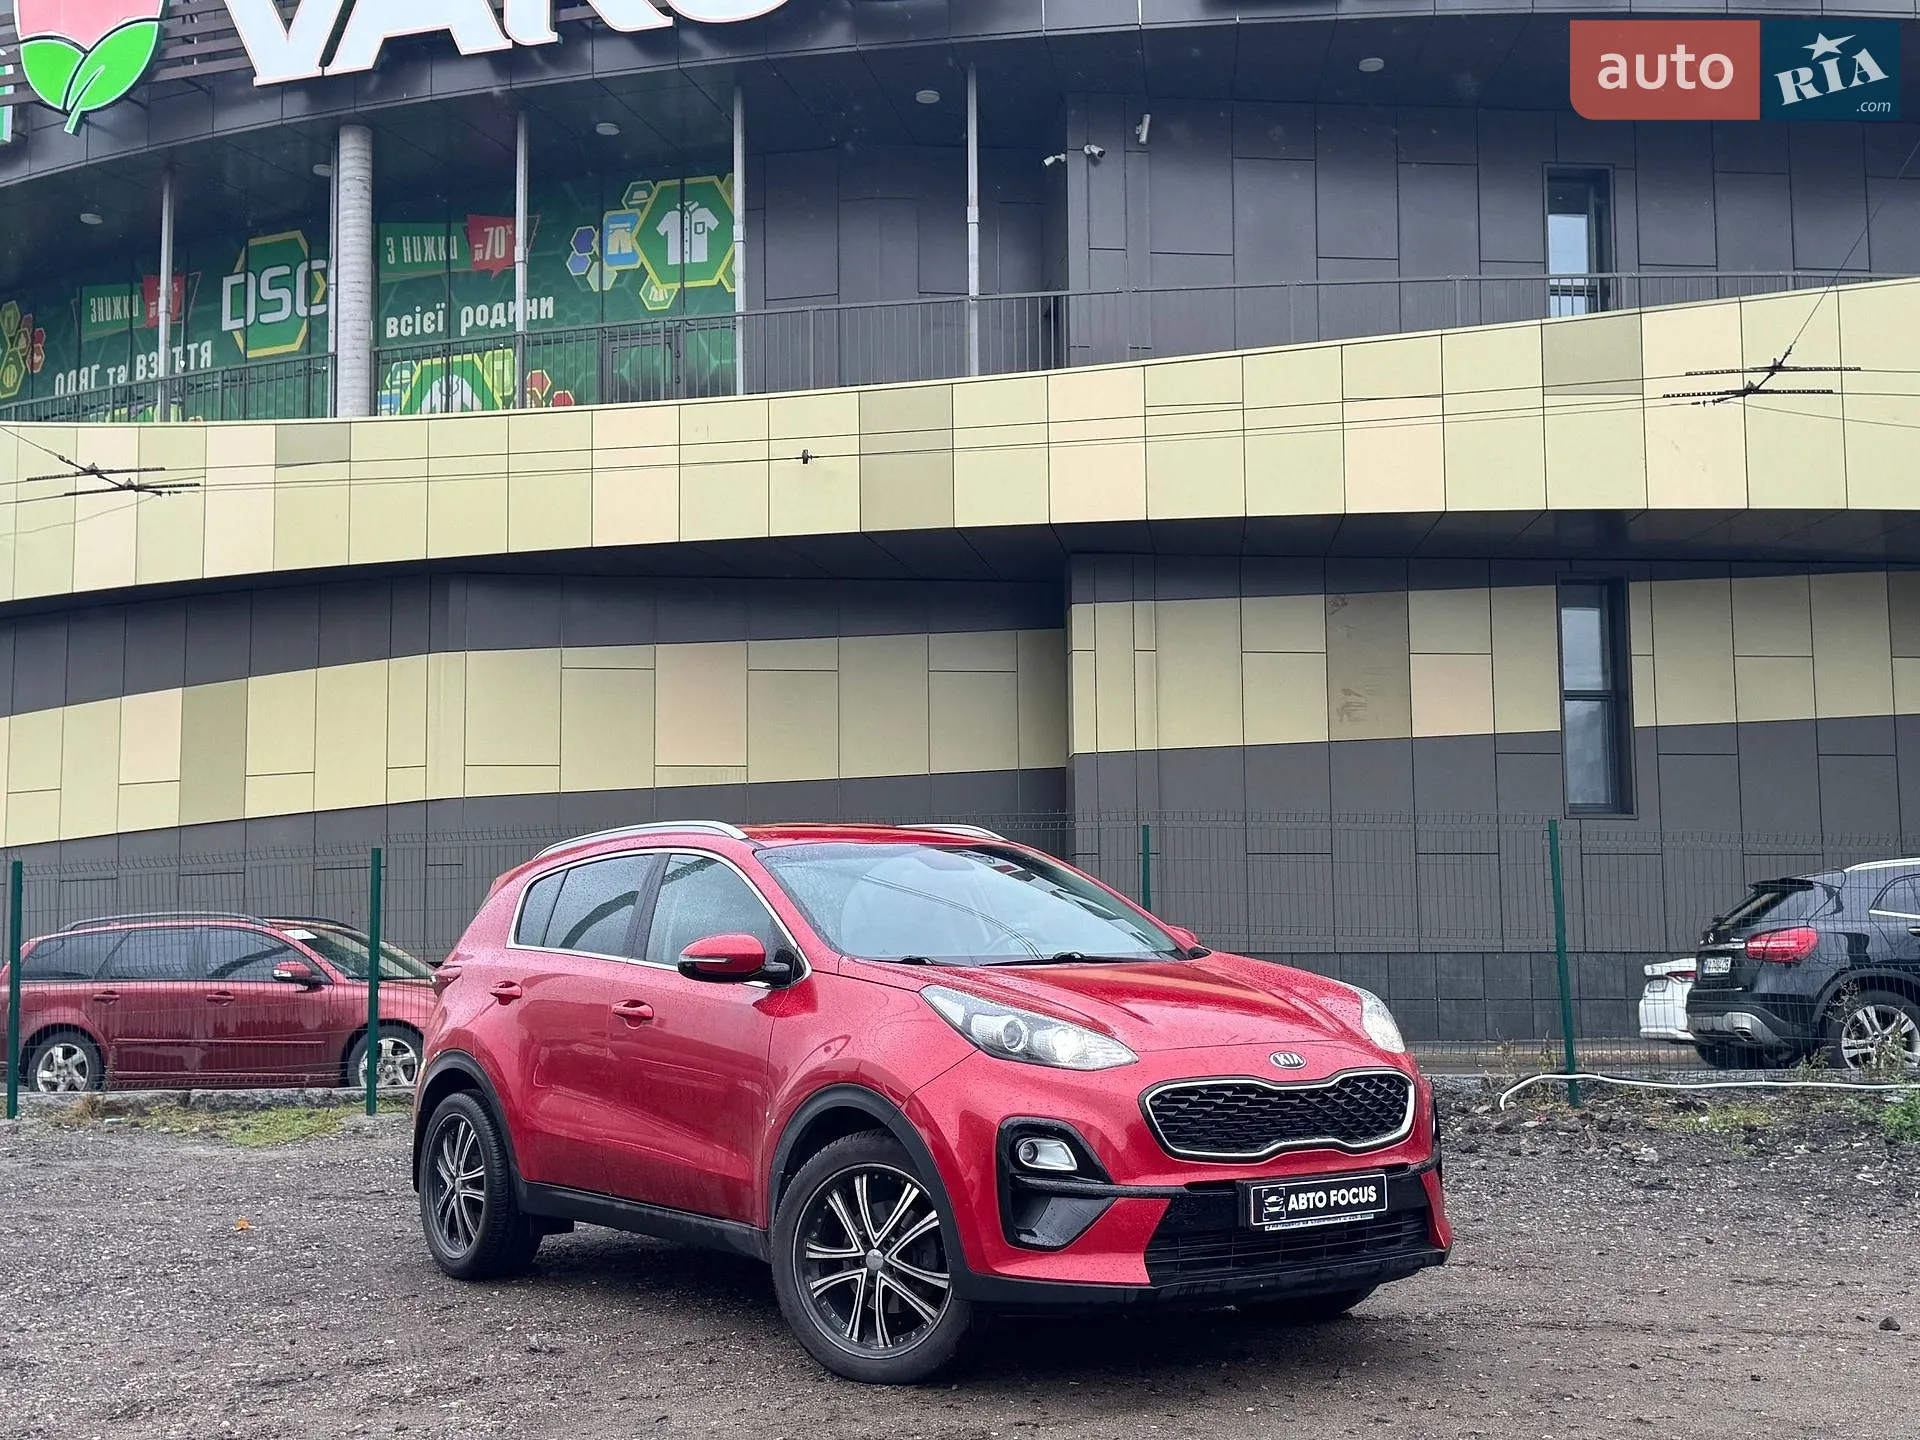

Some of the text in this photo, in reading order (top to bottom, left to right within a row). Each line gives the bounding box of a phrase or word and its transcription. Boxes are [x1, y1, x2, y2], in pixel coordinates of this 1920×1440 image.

[386, 303, 446, 339] всієї
[136, 340, 212, 381] ВЗТТЯ
[1288, 1185, 1377, 1212] АВТО FOCUS
